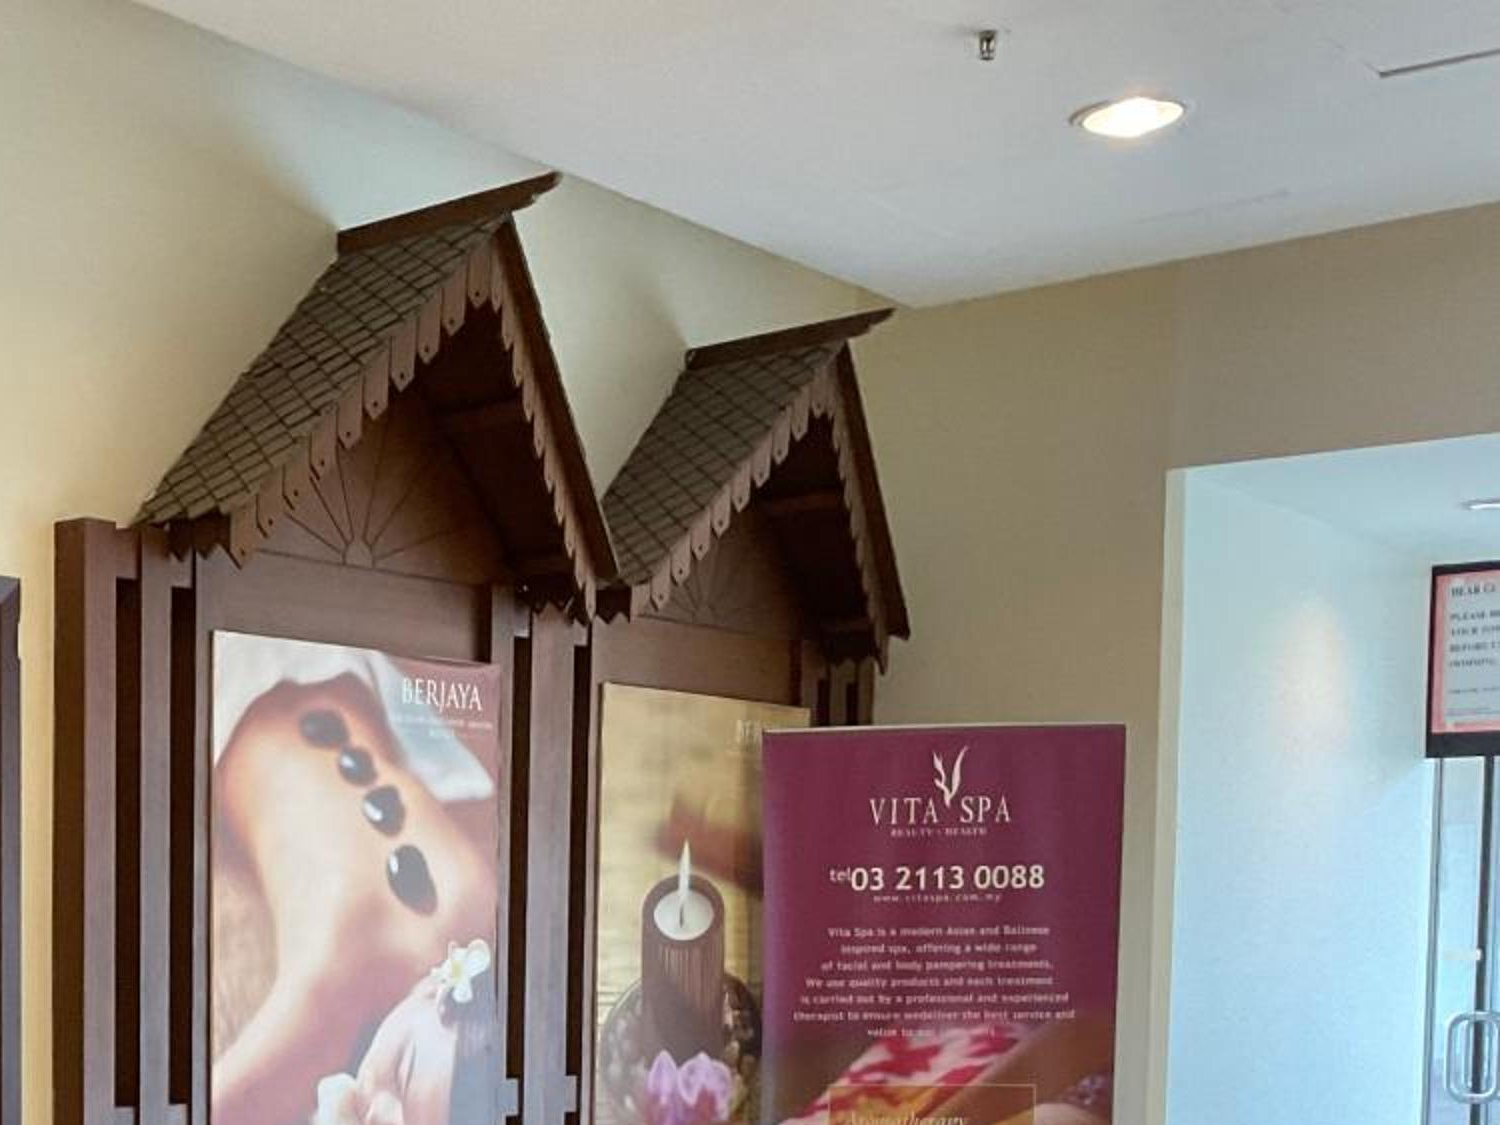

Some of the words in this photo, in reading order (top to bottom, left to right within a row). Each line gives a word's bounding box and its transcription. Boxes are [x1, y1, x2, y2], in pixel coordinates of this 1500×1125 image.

[403, 677, 483, 712] BERJAYA
[869, 797, 939, 825] VITA
[960, 795, 1011, 823] SPA
[895, 864, 965, 891] 2113
[973, 863, 1045, 890] 0088
[827, 928, 851, 937] Vita
[853, 927, 874, 937] Spa
[979, 926, 999, 935] and
[871, 961, 891, 970] and
